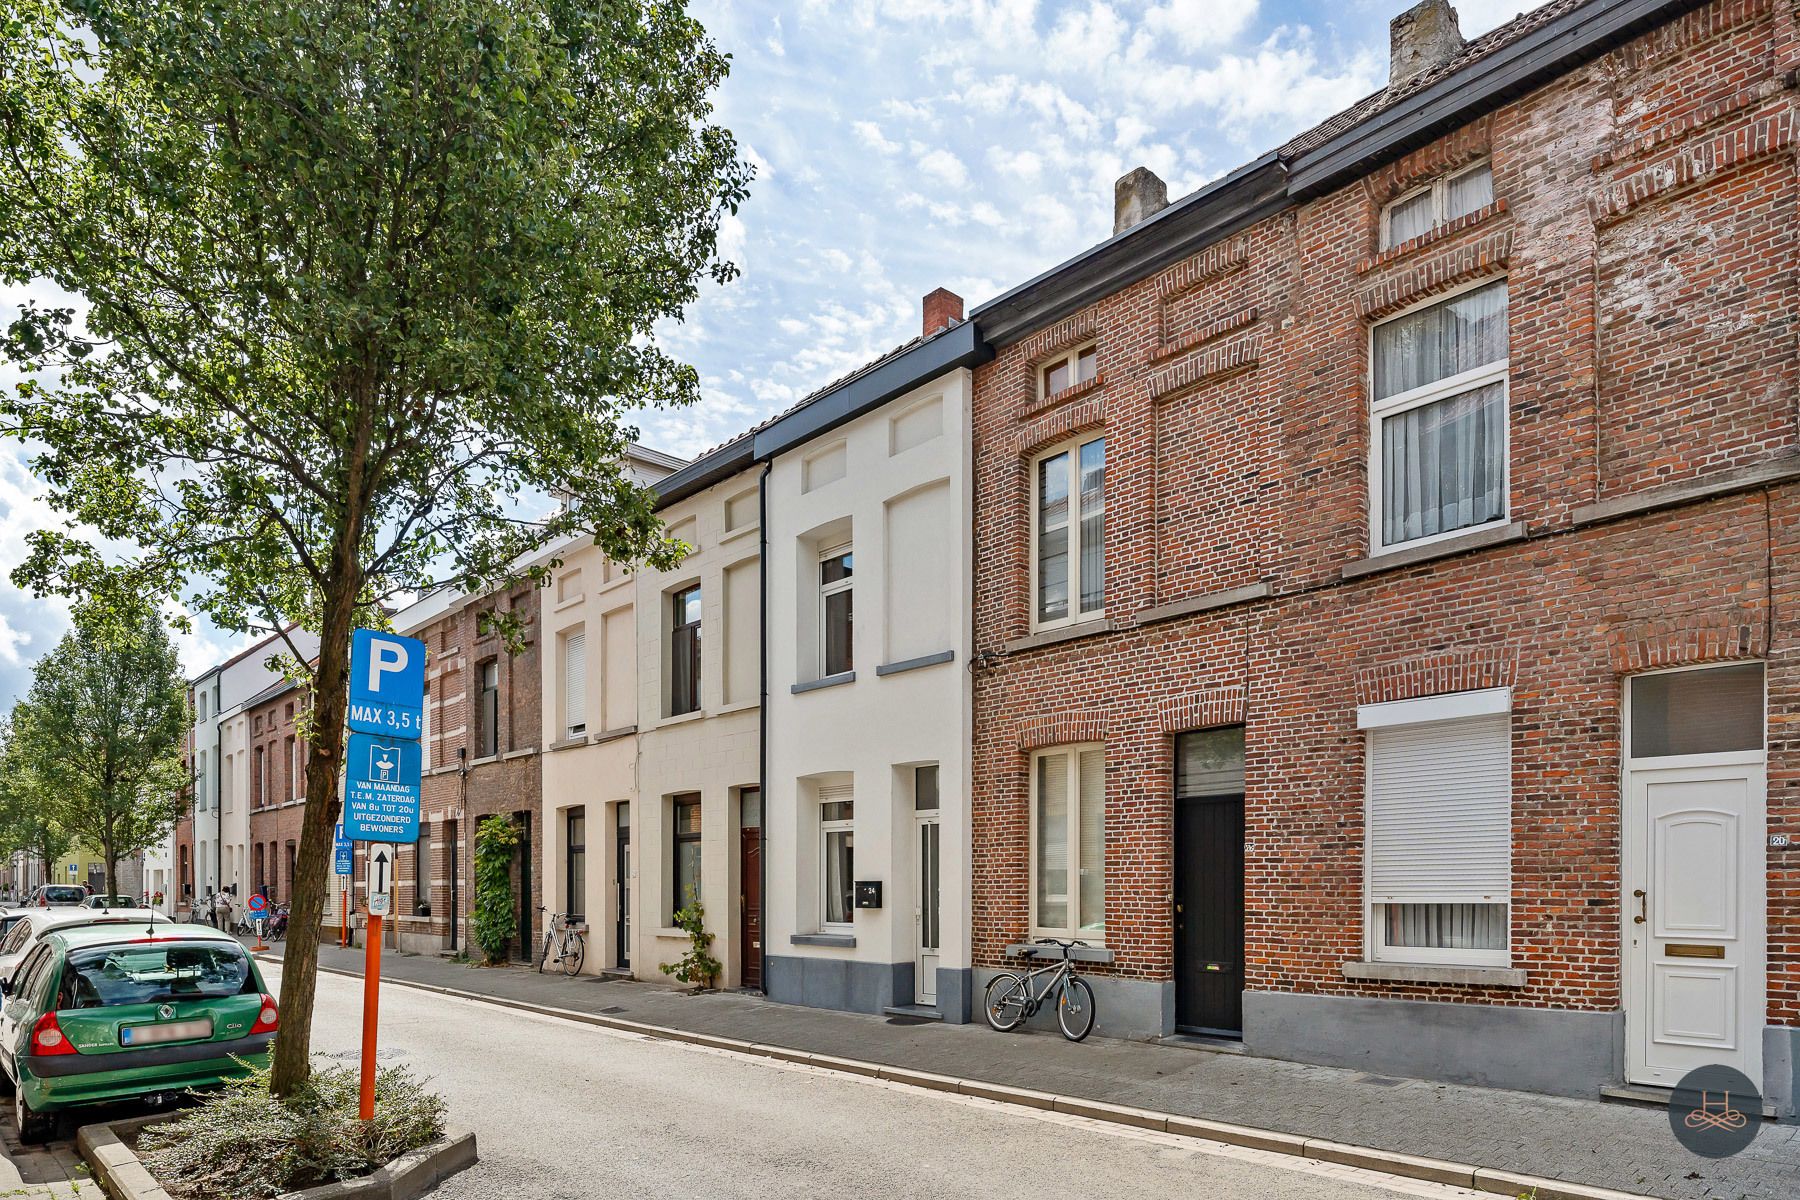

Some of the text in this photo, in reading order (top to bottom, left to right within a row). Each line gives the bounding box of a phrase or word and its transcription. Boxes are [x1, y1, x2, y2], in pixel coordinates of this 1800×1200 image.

[368, 638, 408, 692] P
[351, 705, 421, 729] MAX 3,5 t
[357, 782, 410, 793] VAN MAANDAG
[350, 791, 415, 804] T.E.M. ZATERDAG
[352, 802, 414, 814] VAN 8u TOT 20u
[354, 812, 411, 824] UITGEZONDERD
[360, 823, 404, 834] BEWONERS
